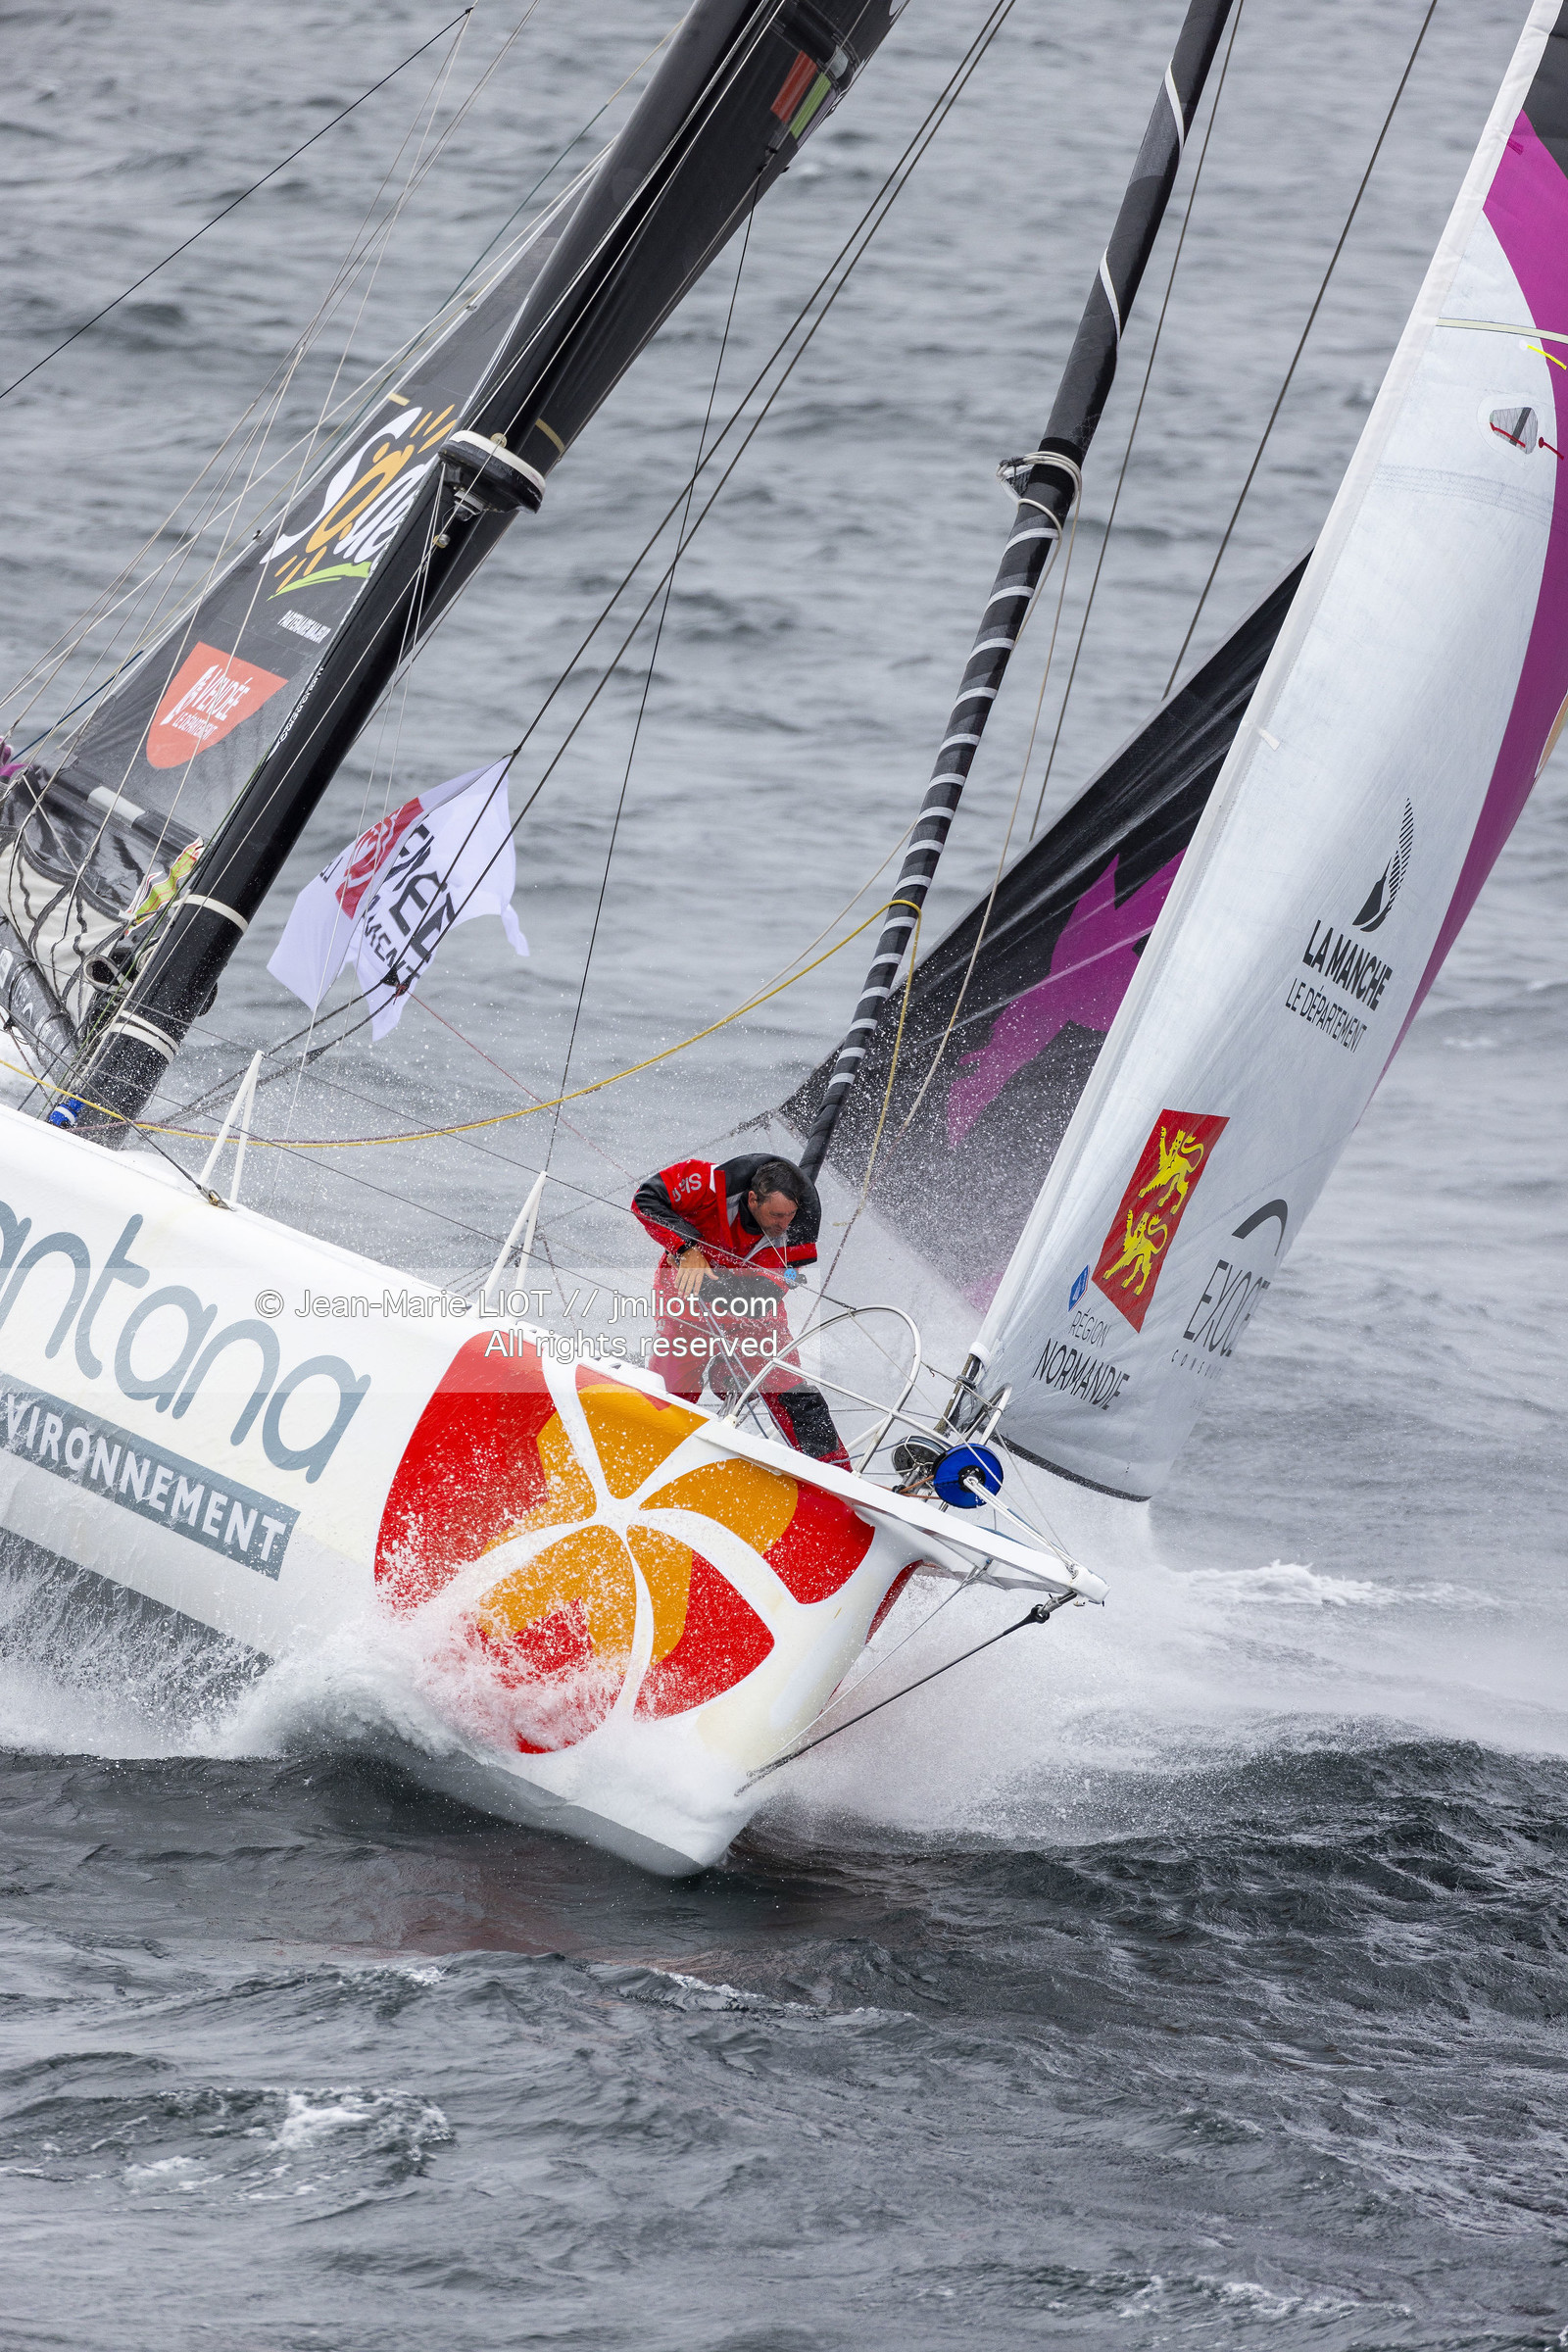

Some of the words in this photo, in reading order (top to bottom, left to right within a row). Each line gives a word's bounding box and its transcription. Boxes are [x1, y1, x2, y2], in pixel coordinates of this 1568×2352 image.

[191, 668, 253, 721] VENDÉE
[1302, 919, 1334, 973] LA
[1324, 934, 1393, 1011] MANCHE
[1285, 978, 1306, 1012] LE
[1299, 985, 1368, 1054] DÉPARTEMENT
[1068, 1307, 1111, 1348] RÉGION
[1032, 1338, 1130, 1410] NORMANDIE
